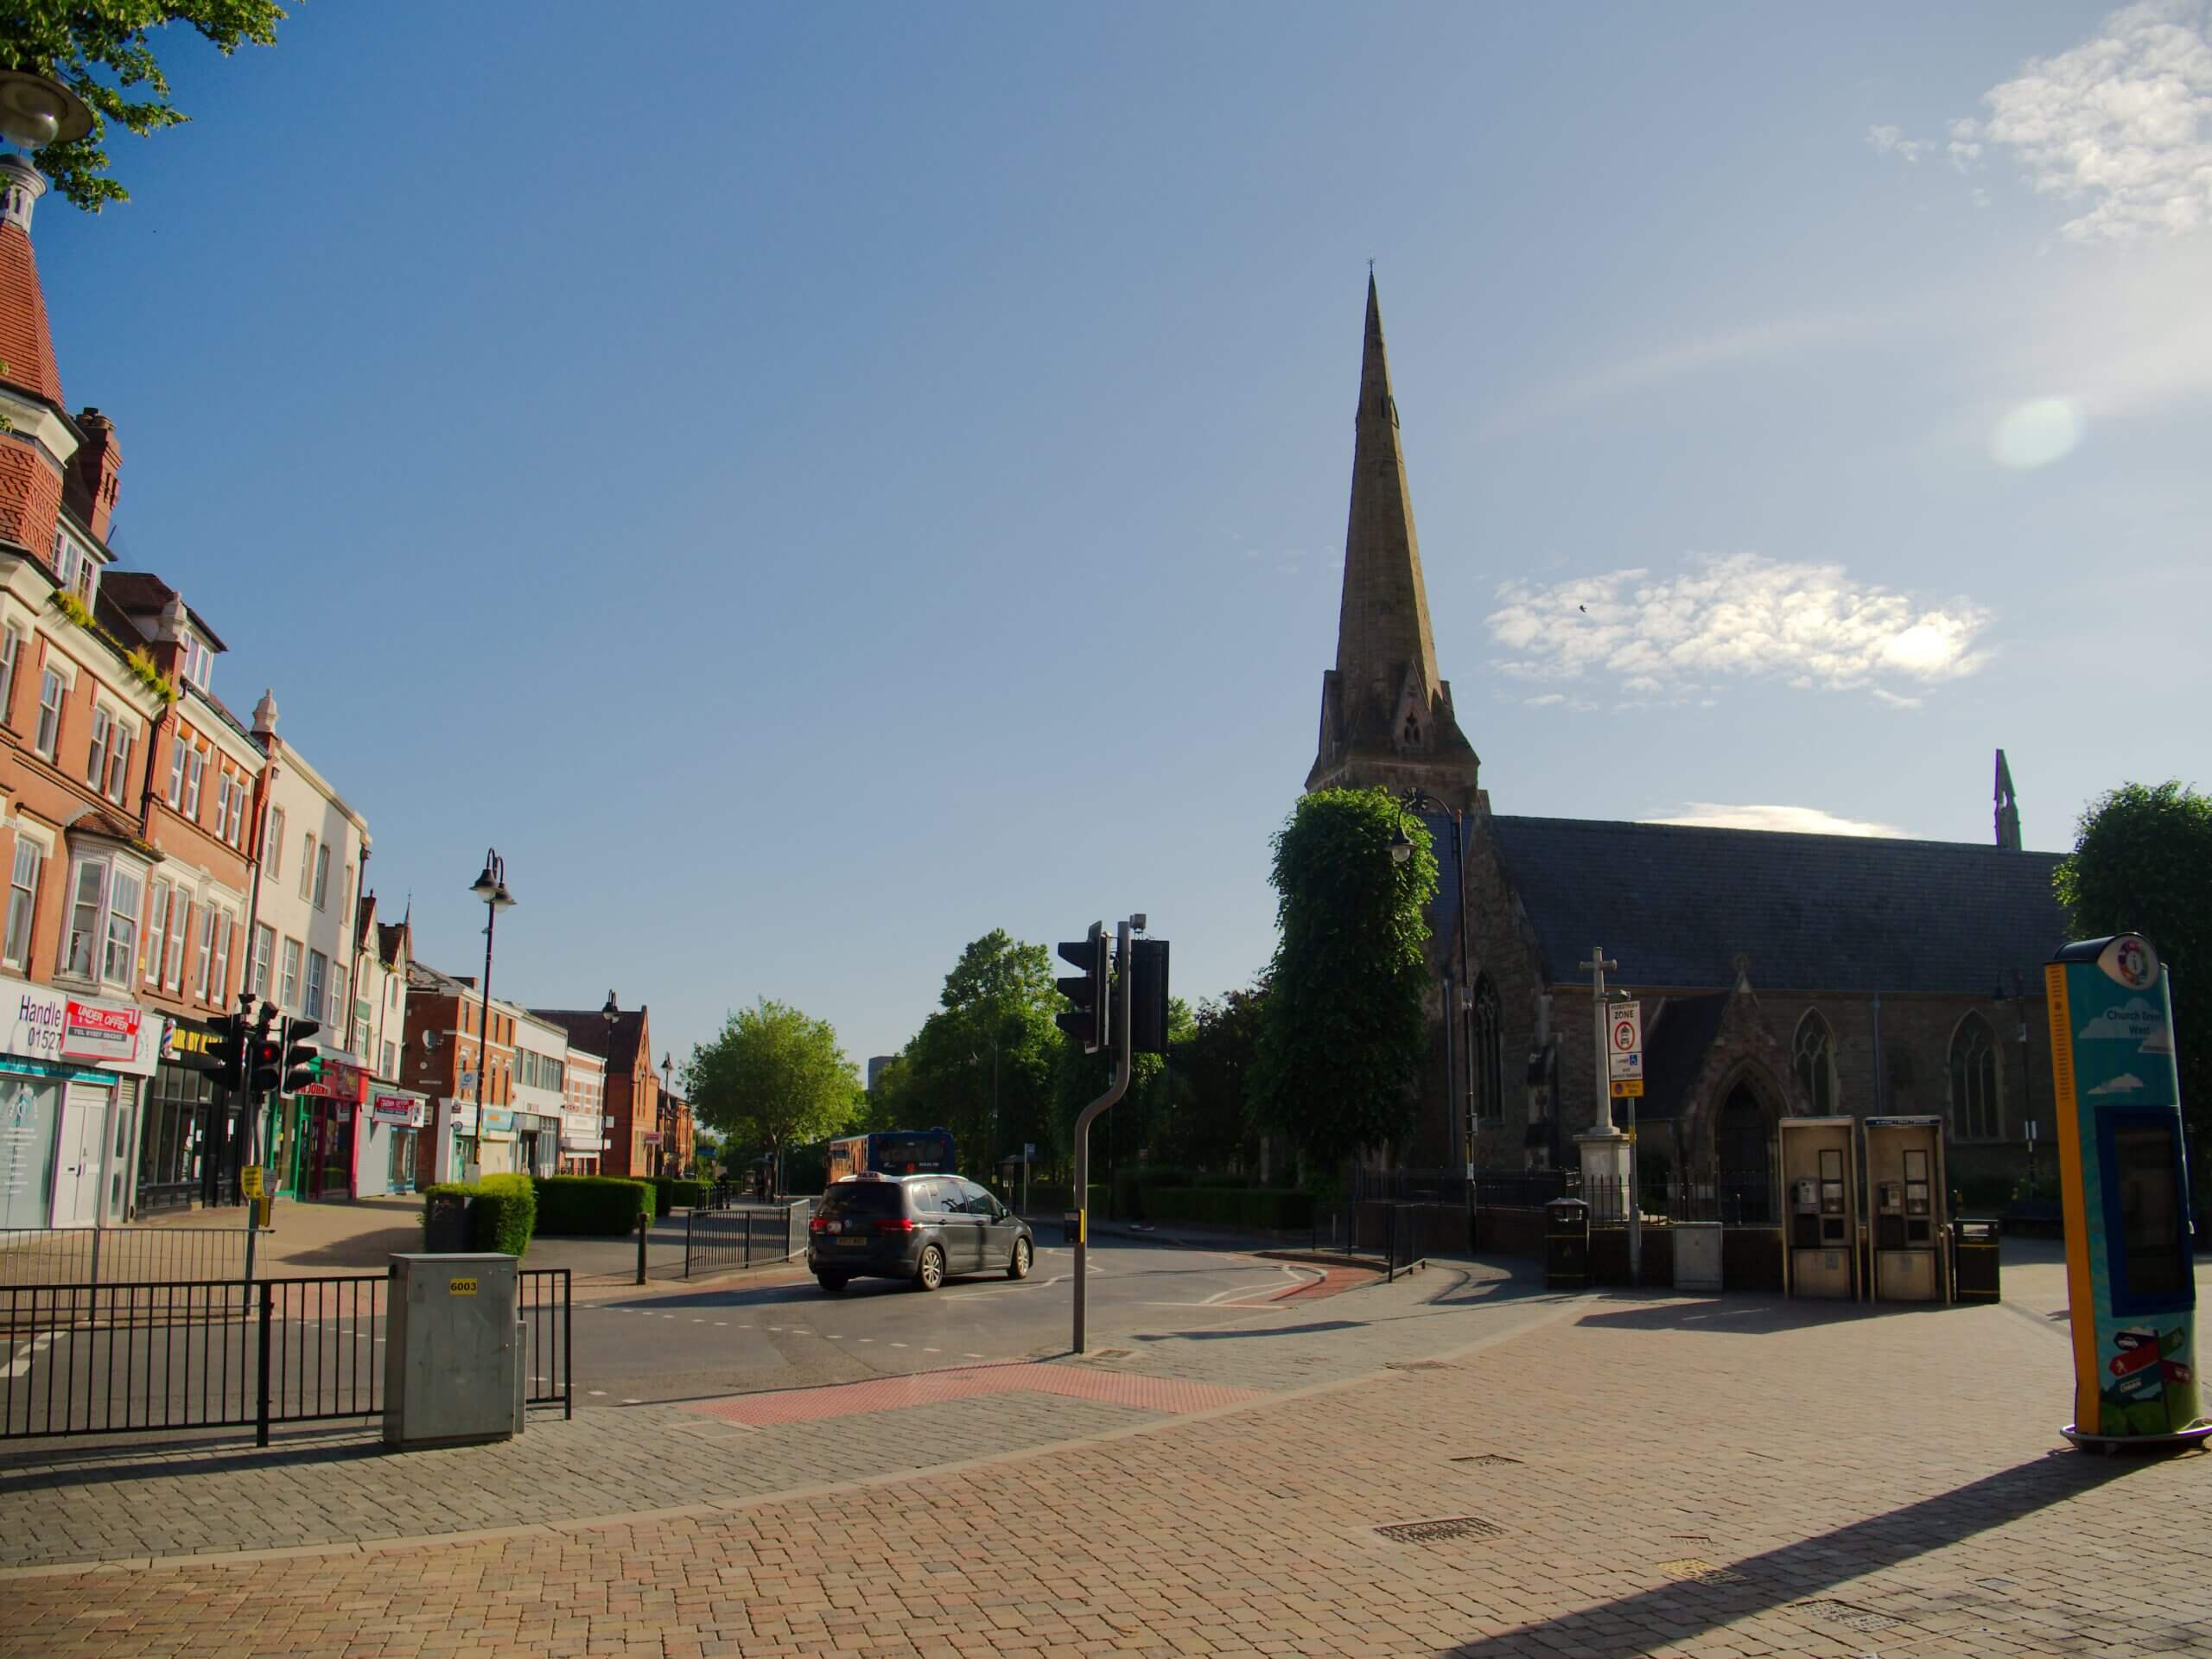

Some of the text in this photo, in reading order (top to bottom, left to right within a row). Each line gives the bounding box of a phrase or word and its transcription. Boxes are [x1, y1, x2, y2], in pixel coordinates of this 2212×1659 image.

[19, 995, 61, 1027] Handle
[78, 1005, 129, 1031] UNDER OFFER
[1614, 1009, 1634, 1020] ZONE
[2107, 1009, 2140, 1020] Church
[28, 1027, 61, 1052] 01527
[450, 1282, 477, 1291] 6003
